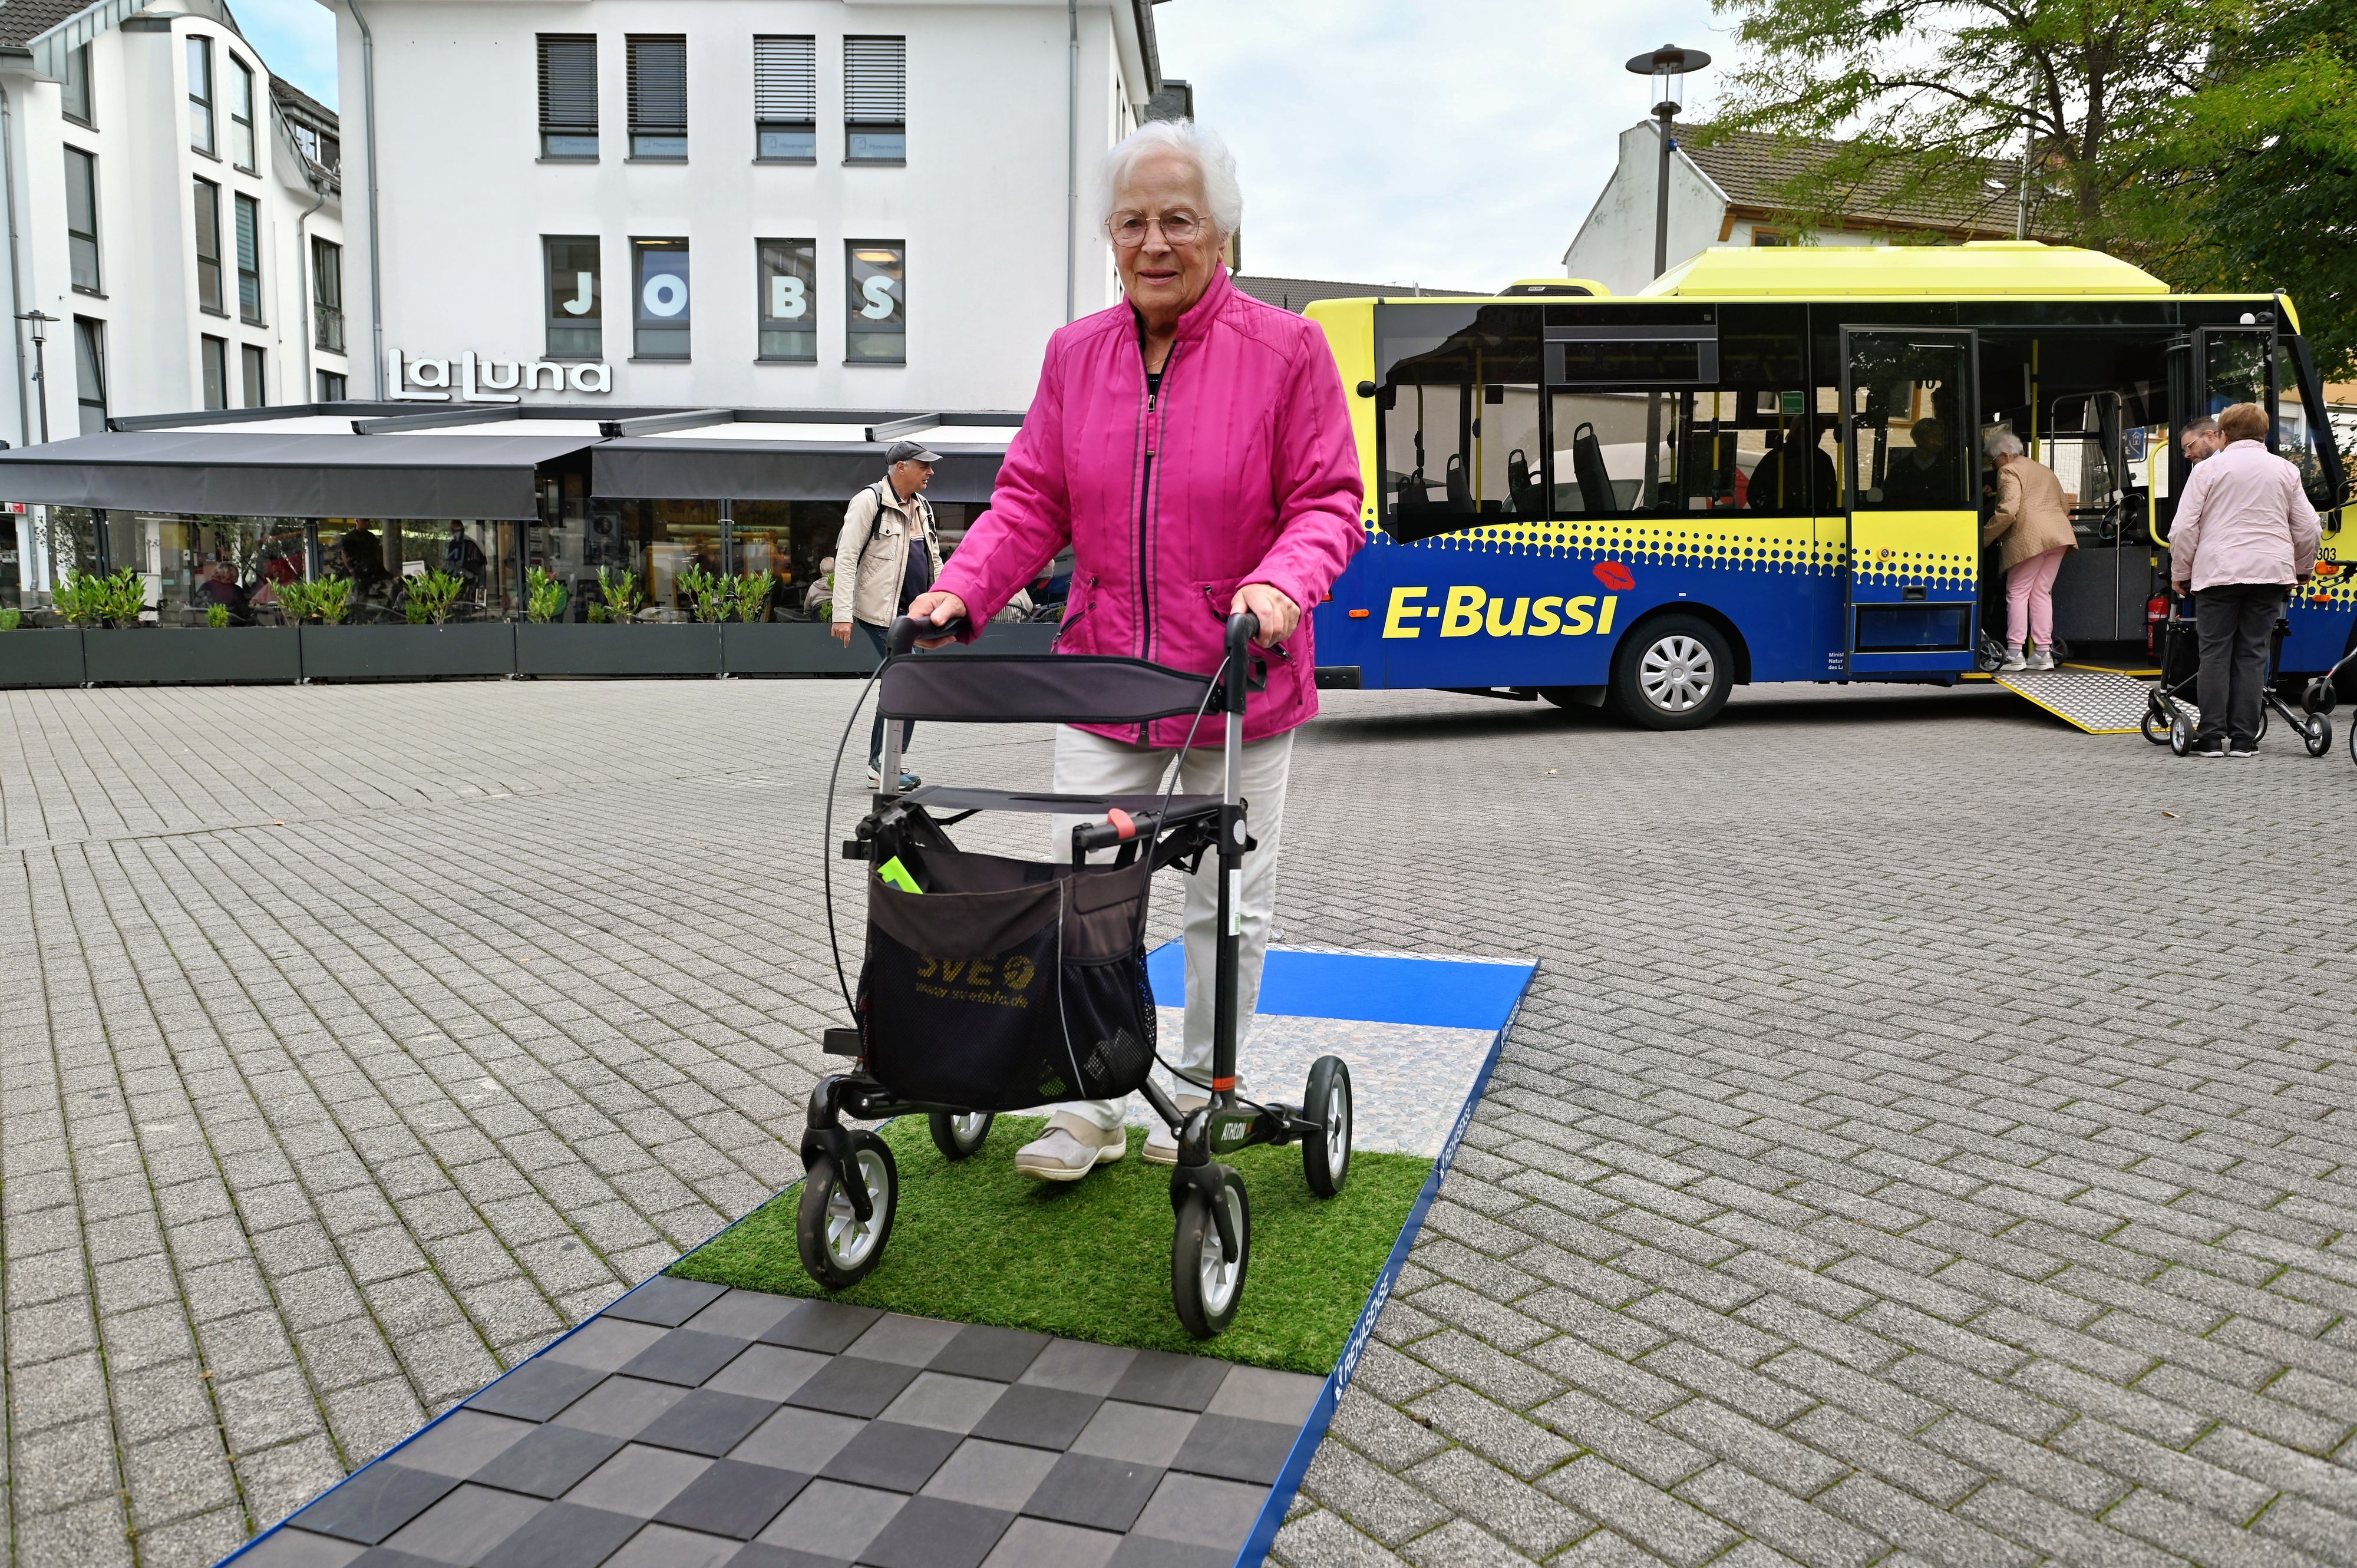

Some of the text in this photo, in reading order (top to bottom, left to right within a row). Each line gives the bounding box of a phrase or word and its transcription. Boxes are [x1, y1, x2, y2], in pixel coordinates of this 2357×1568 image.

[1221, 1122, 1247, 1141] ATHLON
[1445, 1101, 1471, 1168] REHASENSE
[1345, 1272, 1389, 1382] REHASENSE
